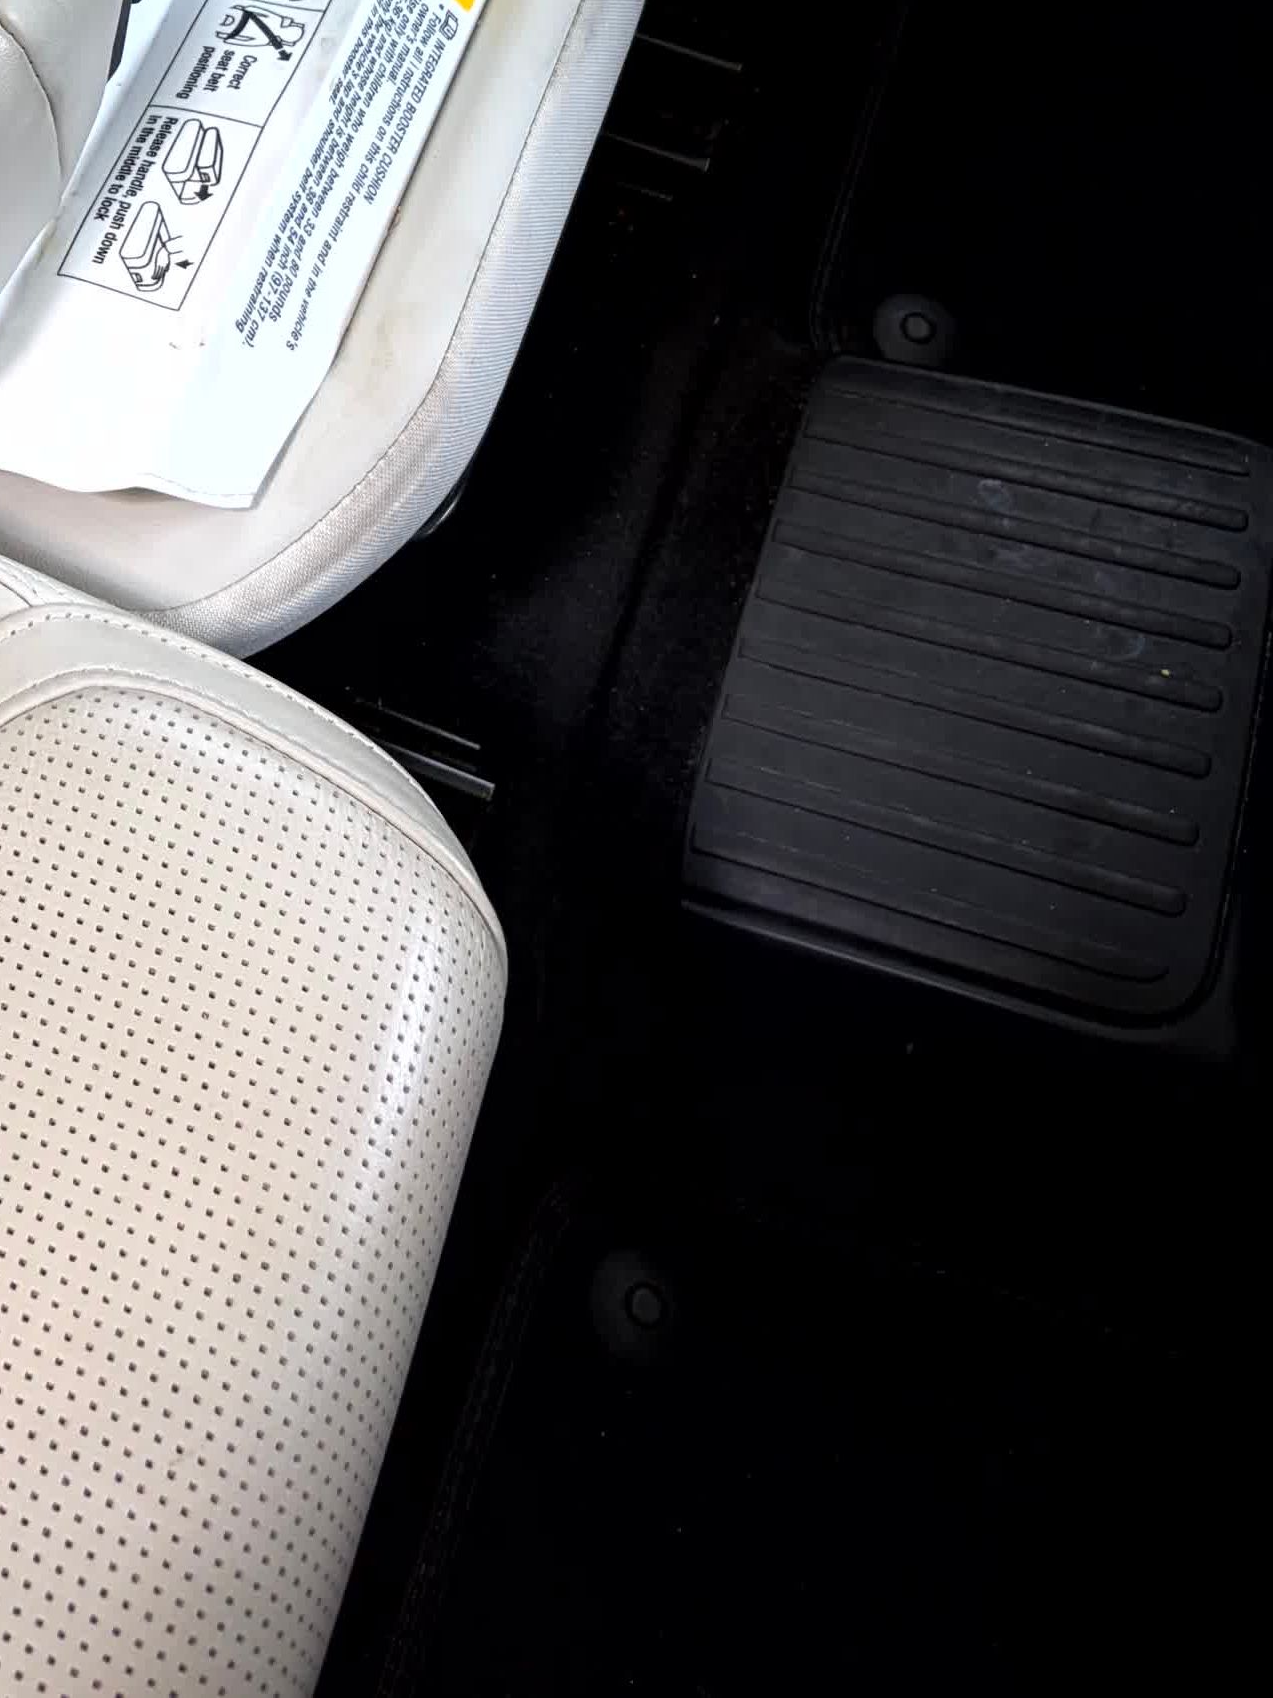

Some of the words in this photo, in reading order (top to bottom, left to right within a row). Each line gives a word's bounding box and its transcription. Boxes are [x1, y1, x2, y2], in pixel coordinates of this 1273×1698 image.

[370, 3, 380, 18] in
[374, 13, 386, 34] the
[393, 13, 410, 39] only
[405, 2, 429, 45] owner's
[360, 16, 374, 39] this
[419, 12, 442, 48] Follow
[214, 49, 235, 71] seat
[341, 36, 364, 79] booster
[373, 33, 387, 59] and
[383, 37, 399, 64] with
[411, 45, 424, 64] all
[175, 45, 215, 99] positioning
[202, 71, 225, 92] belt
[226, 54, 258, 90] Correct
[357, 55, 377, 92] whose
[362, 62, 387, 108] children
[410, 37, 446, 104] INTEGRATED
[342, 78, 355, 99] lap
[332, 96, 347, 122] and
[340, 90, 362, 128] height
[350, 107, 367, 133] who
[134, 126, 155, 144] the
[145, 116, 179, 158] Release
[309, 118, 335, 169] shoulder
[334, 125, 346, 139] is
[374, 125, 387, 143] on
[386, 101, 417, 155] BOOSTER
[114, 145, 143, 181] middle
[312, 137, 339, 187] between
[334, 132, 355, 169] weigh
[364, 141, 381, 164] this
[106, 182, 124, 195] to
[121, 159, 156, 198] handle,
[311, 167, 340, 218] between
[351, 162, 369, 195] child
[363, 152, 393, 205] CUSHION
[93, 196, 118, 221] lock
[109, 199, 132, 230] push
[277, 190, 302, 234] system
[293, 202, 308, 229] and
[328, 191, 356, 242] restraint
[286, 225, 299, 246] 54
[302, 217, 316, 237] 33
[91, 231, 118, 264] down
[264, 233, 282, 268] when
[277, 242, 292, 271] inch
[293, 233, 306, 262] and
[316, 239, 332, 267] and
[310, 262, 323, 278] in
[234, 266, 268, 333] restraining
[256, 270, 284, 322] (97-137
[268, 273, 294, 322] pounds
[304, 276, 317, 298] the
[241, 318, 259, 348] cm).
[285, 298, 309, 351] vehicle's
